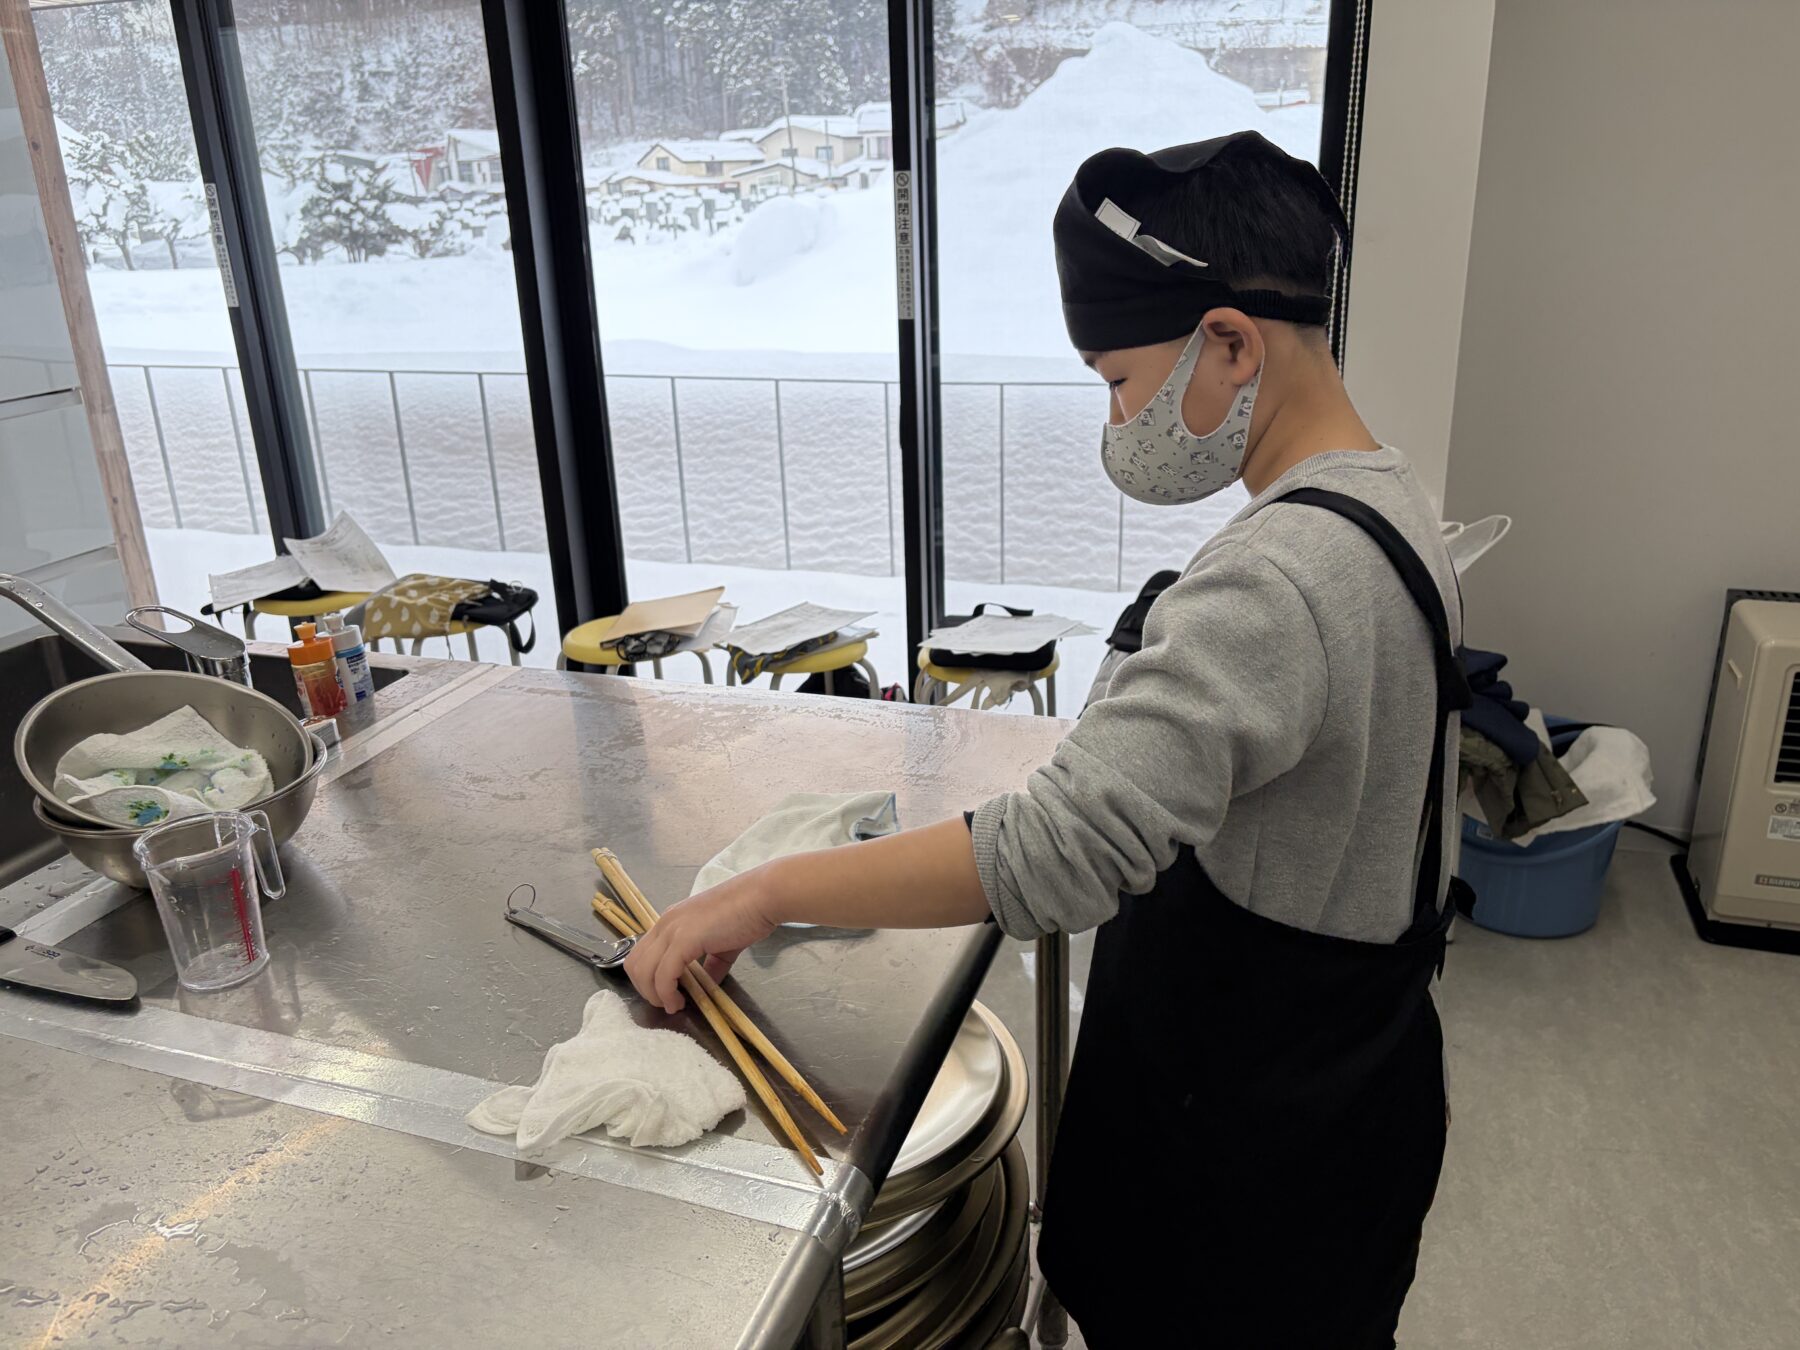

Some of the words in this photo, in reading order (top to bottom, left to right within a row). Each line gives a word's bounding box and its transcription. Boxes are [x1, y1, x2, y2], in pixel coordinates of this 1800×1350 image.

[207, 198, 223, 245] 開閉注意
[897, 188, 910, 245] 開閉注意
